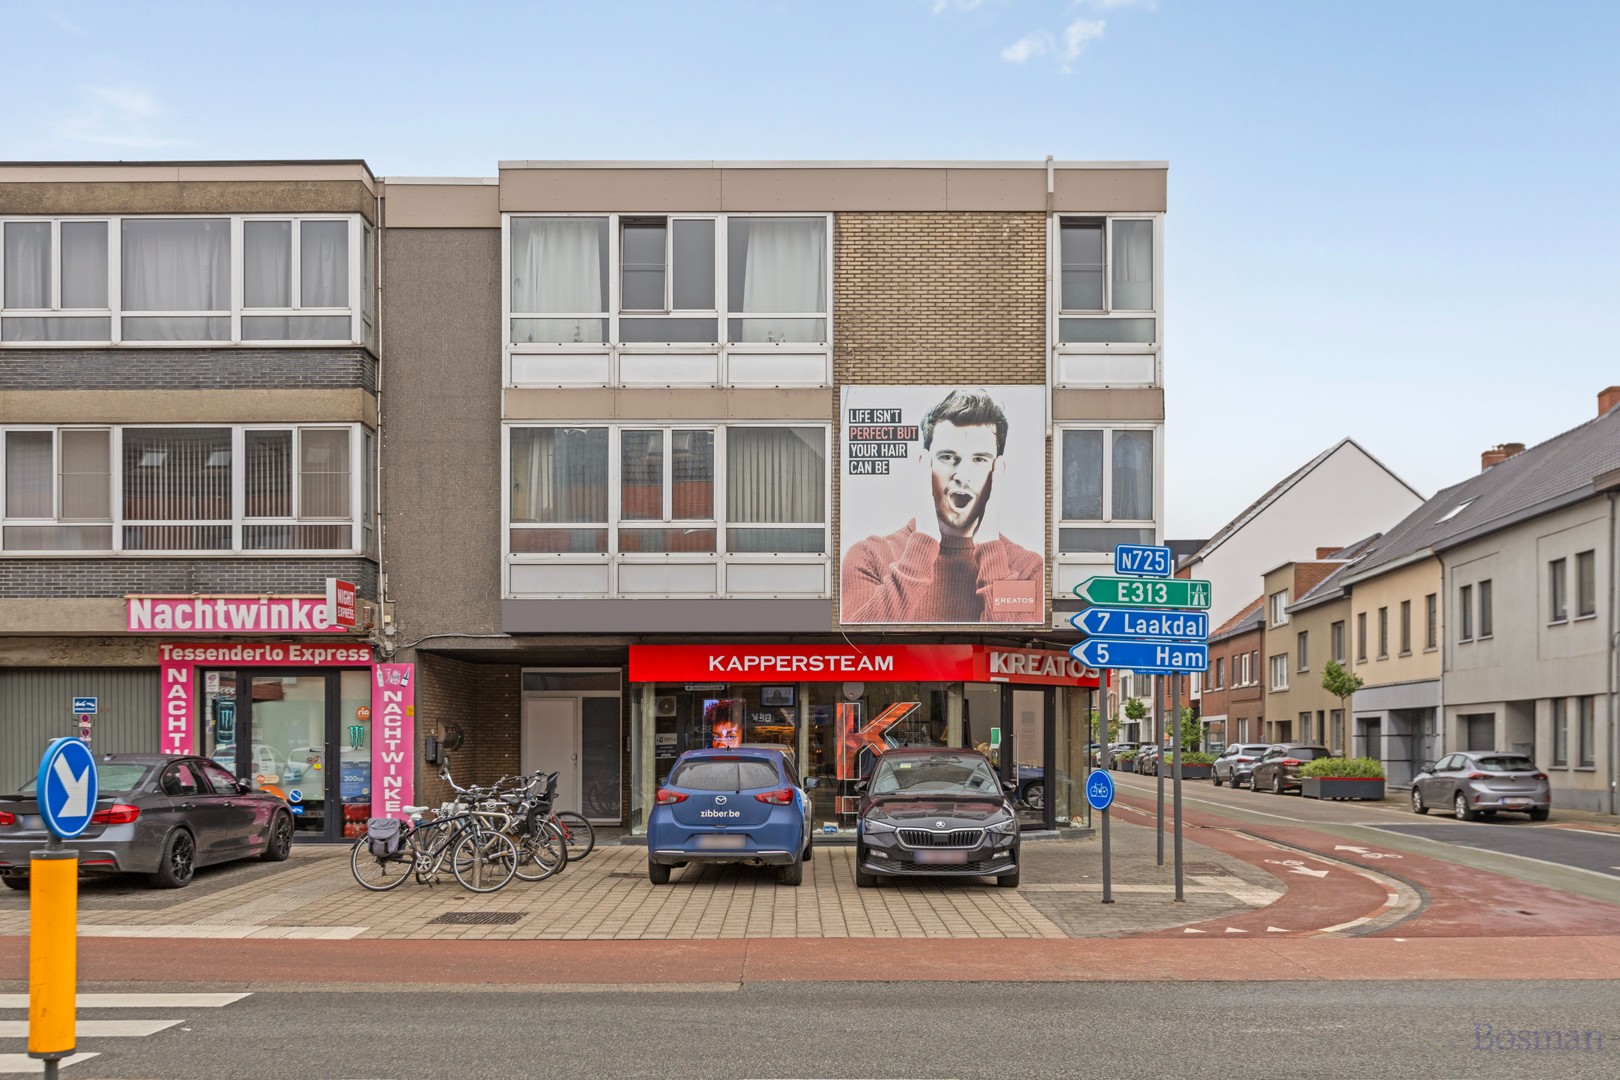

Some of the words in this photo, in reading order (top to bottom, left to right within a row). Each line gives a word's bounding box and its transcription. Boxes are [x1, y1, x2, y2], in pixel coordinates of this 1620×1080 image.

[850, 409, 871, 422] LIFE
[874, 409, 901, 422] ISN'T
[850, 427, 894, 440] PERFECT
[897, 427, 917, 440] BUT
[851, 444, 878, 457] YOUR
[881, 444, 906, 457] HAIR
[850, 461, 872, 474] CAN
[875, 461, 888, 474] BE
[1122, 551, 1165, 571] N725
[337, 588, 354, 606] NIGHT
[1117, 582, 1168, 603] E313
[994, 597, 1034, 605] KREATOS
[130, 599, 344, 630] Nachtwinke
[337, 606, 355, 620] EXPRESS
[1097, 613, 1110, 632] 7
[1124, 613, 1203, 636] Laakdal
[161, 645, 283, 661] Tessenderlo
[289, 645, 369, 664] Express
[1097, 644, 1110, 663] 5
[1156, 646, 1203, 667] Ham
[709, 655, 893, 671] KAPPERSTEAM
[700, 809, 740, 818] zibber.be
